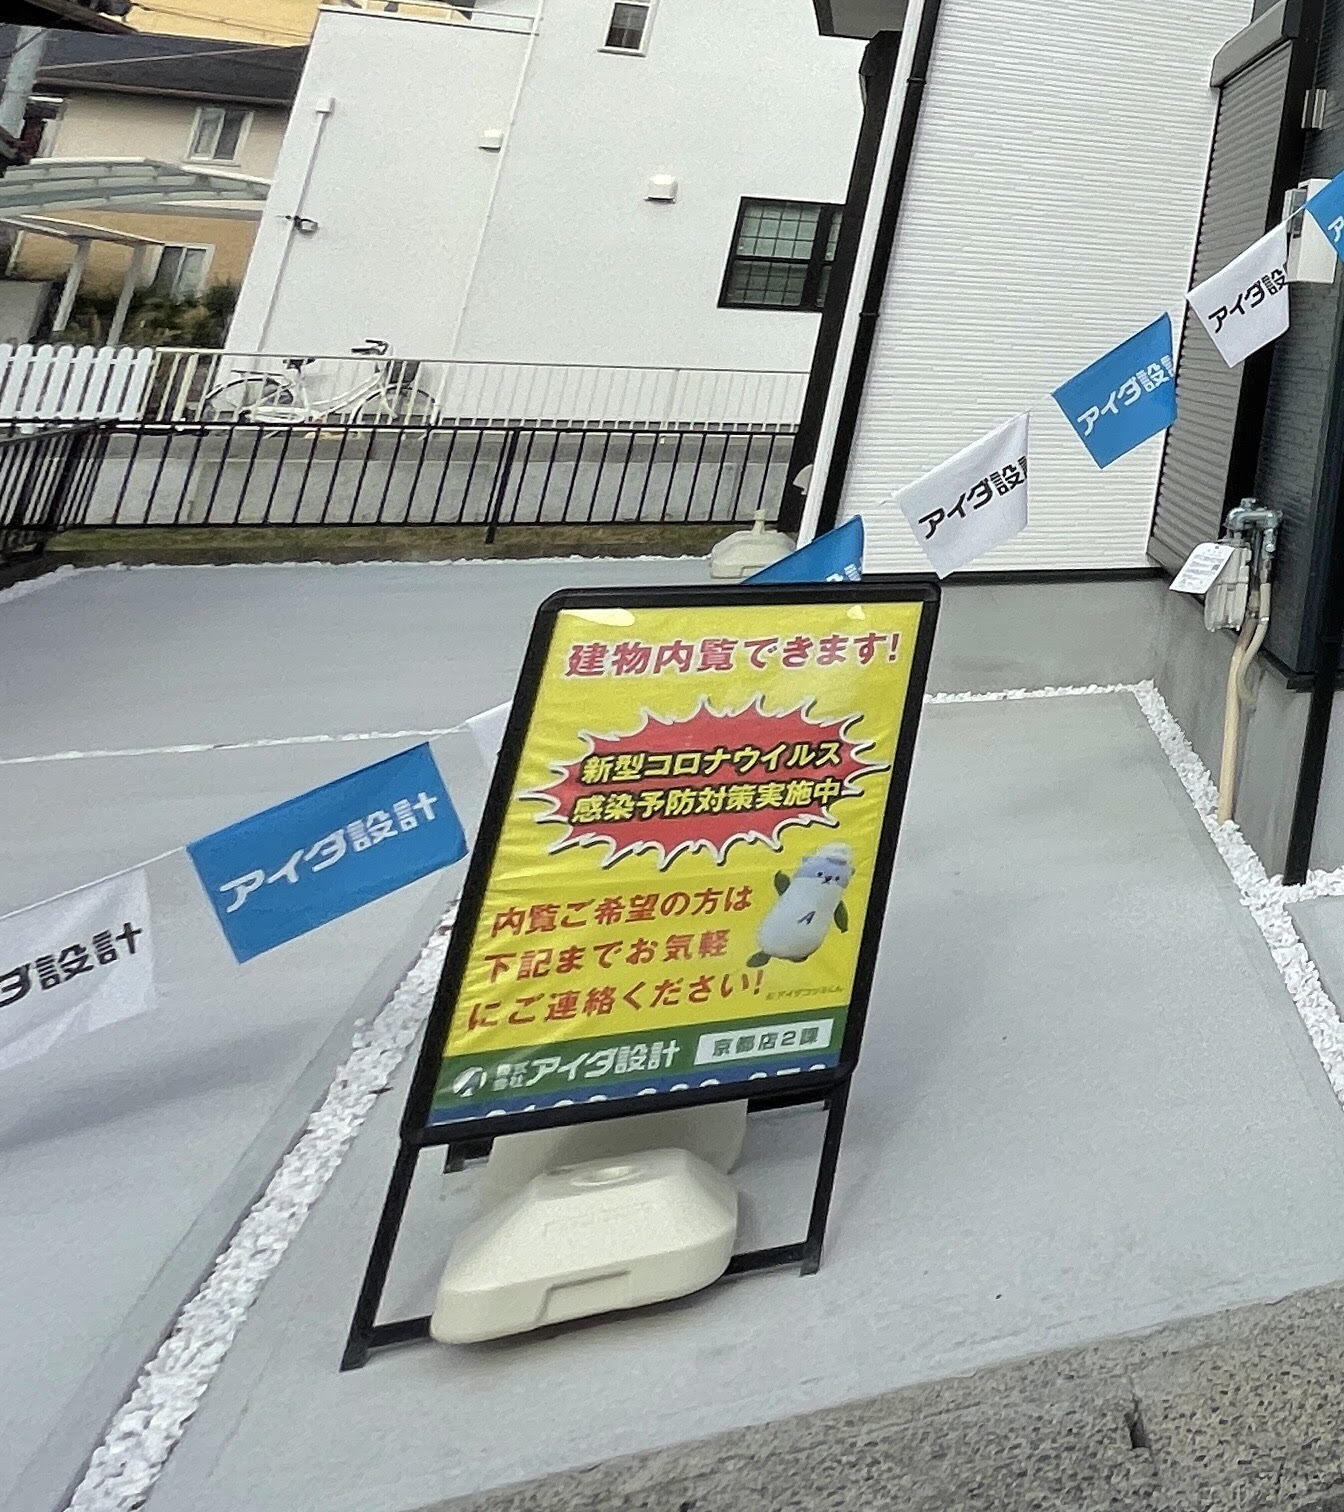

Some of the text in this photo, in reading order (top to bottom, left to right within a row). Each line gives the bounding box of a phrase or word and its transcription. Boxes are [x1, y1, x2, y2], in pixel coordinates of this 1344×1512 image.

[1208, 263, 1288, 334] アイダ設
[564, 632, 901, 678] 建物内覧できます!
[581, 741, 842, 785] 新型コロナウイルス
[571, 778, 842, 825] 感染予防対策実施中
[219, 790, 438, 913] アイダ設計
[490, 885, 753, 938] 内覧ご希望の方は
[484, 928, 731, 984] 下記までお気軽
[467, 970, 765, 1032] にご連絡ください!
[526, 1039, 682, 1088] アイダ設計
